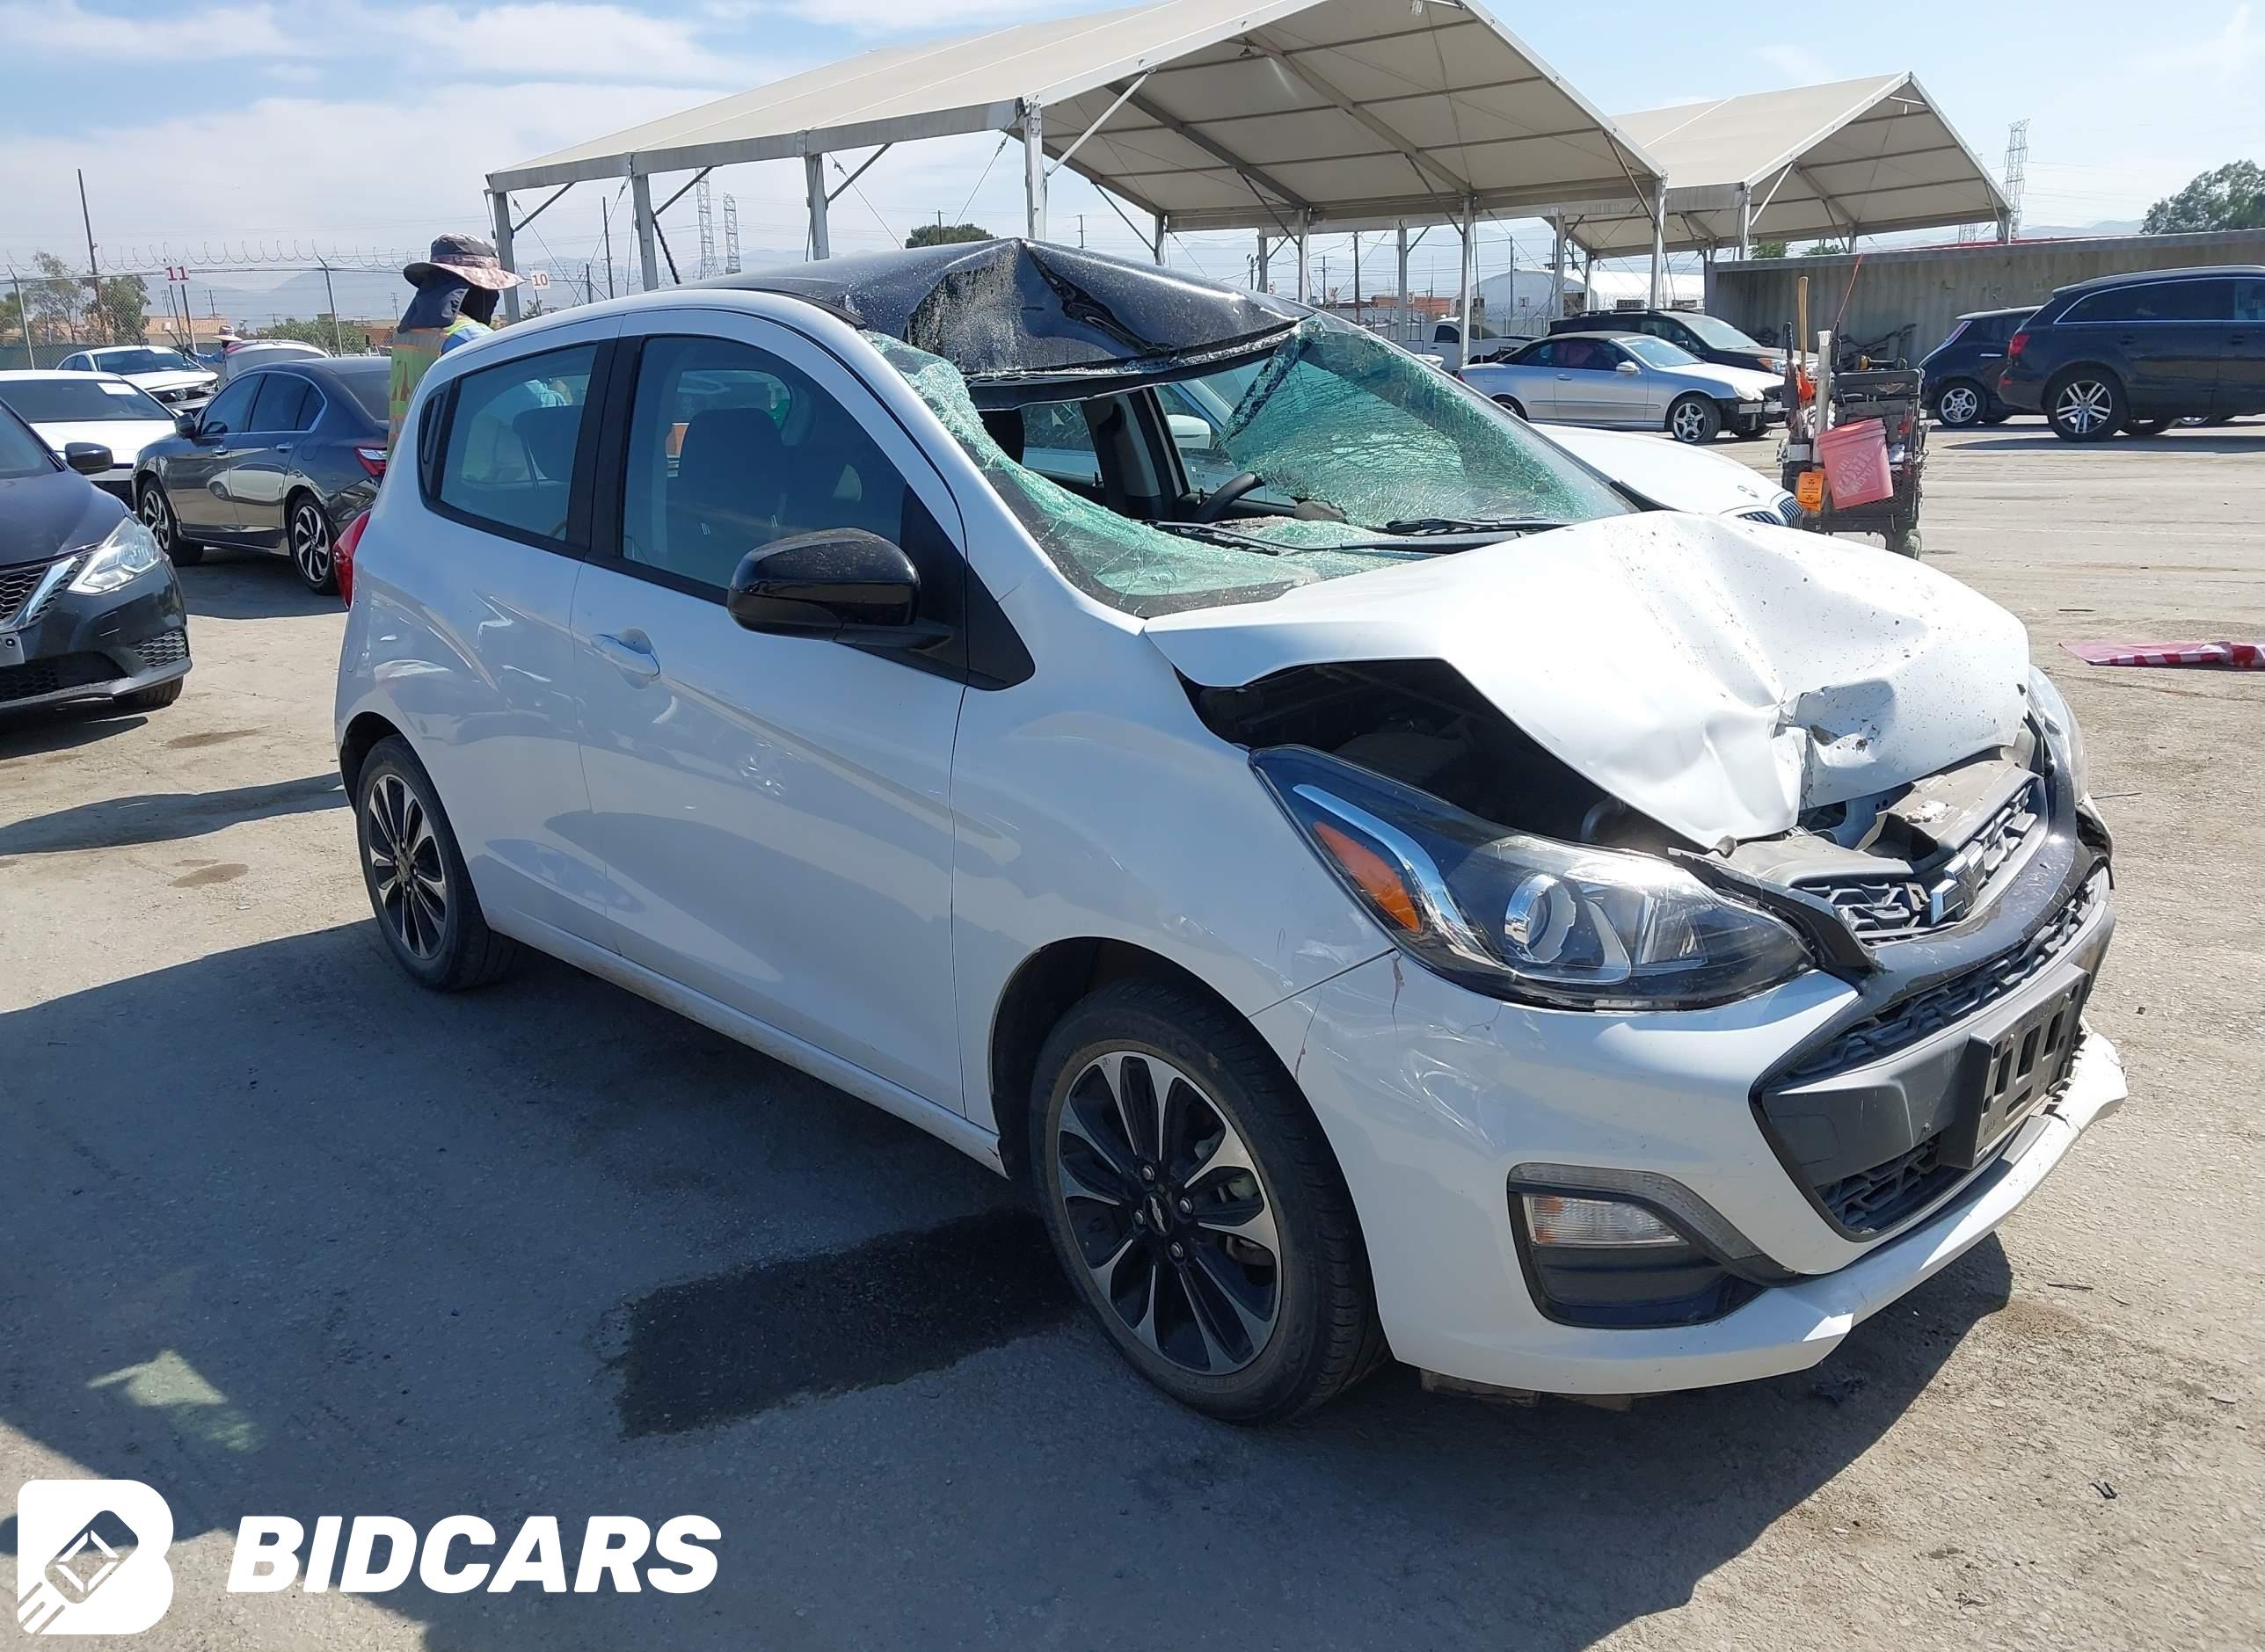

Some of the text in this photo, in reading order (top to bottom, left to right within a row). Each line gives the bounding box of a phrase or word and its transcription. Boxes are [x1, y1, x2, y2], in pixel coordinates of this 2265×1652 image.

[165, 266, 189, 280] 11
[532, 273, 549, 287] 10
[1268, 284, 1274, 295] 5
[1408, 292, 1413, 303] 3
